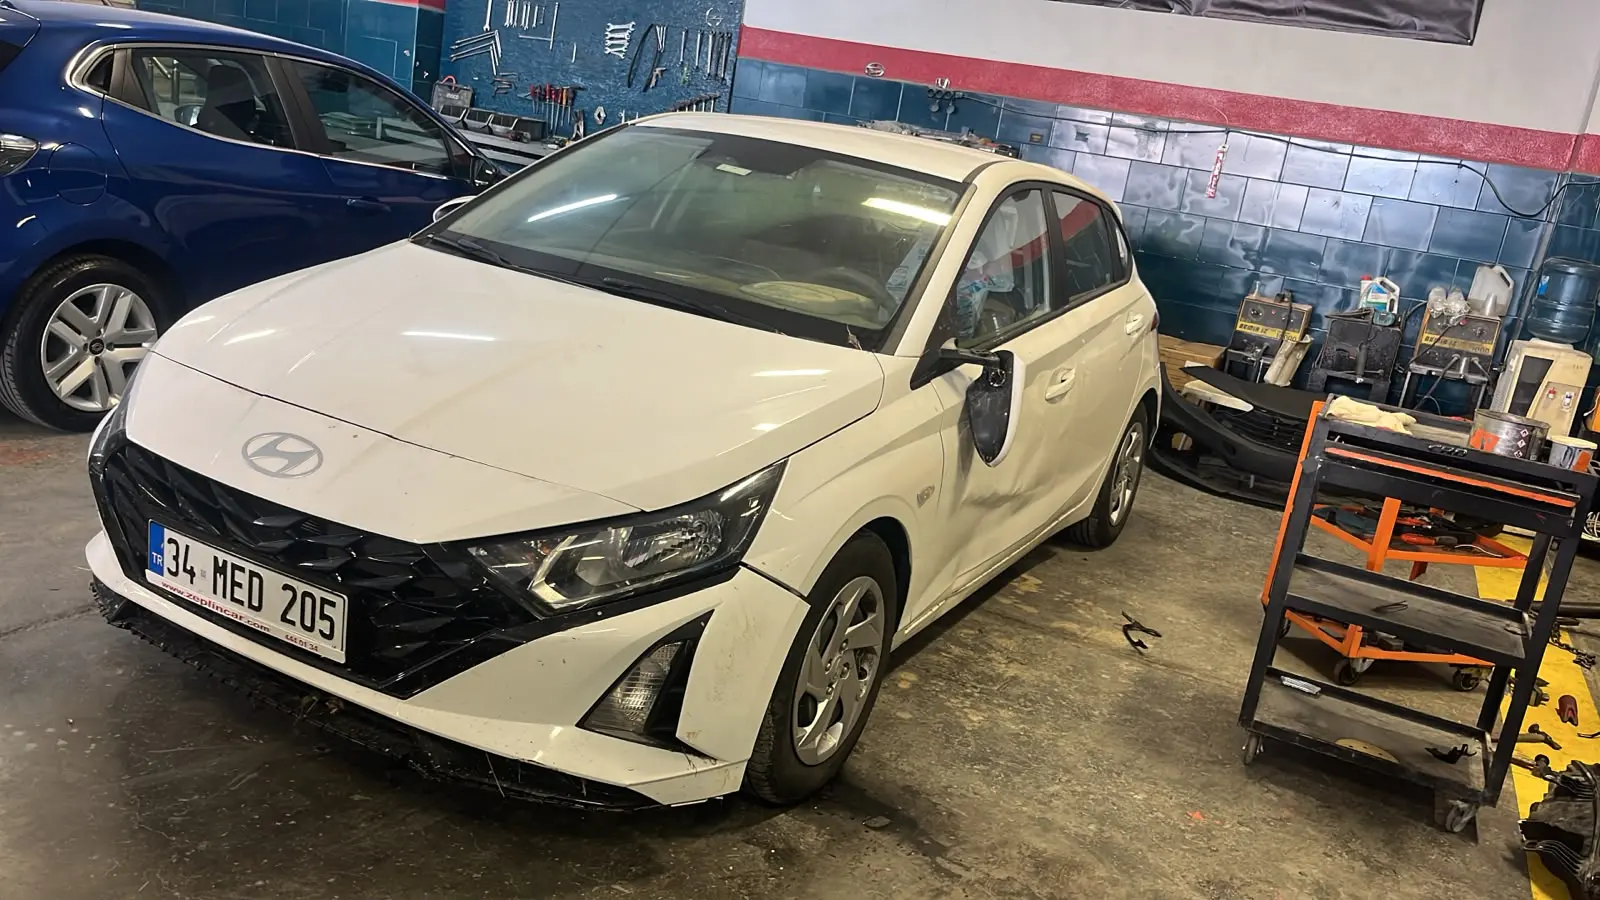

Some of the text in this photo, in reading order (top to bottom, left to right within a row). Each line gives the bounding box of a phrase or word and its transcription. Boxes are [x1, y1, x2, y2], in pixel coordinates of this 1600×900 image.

[152, 552, 163, 567] TR
[161, 581, 271, 632] www.zeplincar.com
[166, 537, 336, 641] 34 MED 205
